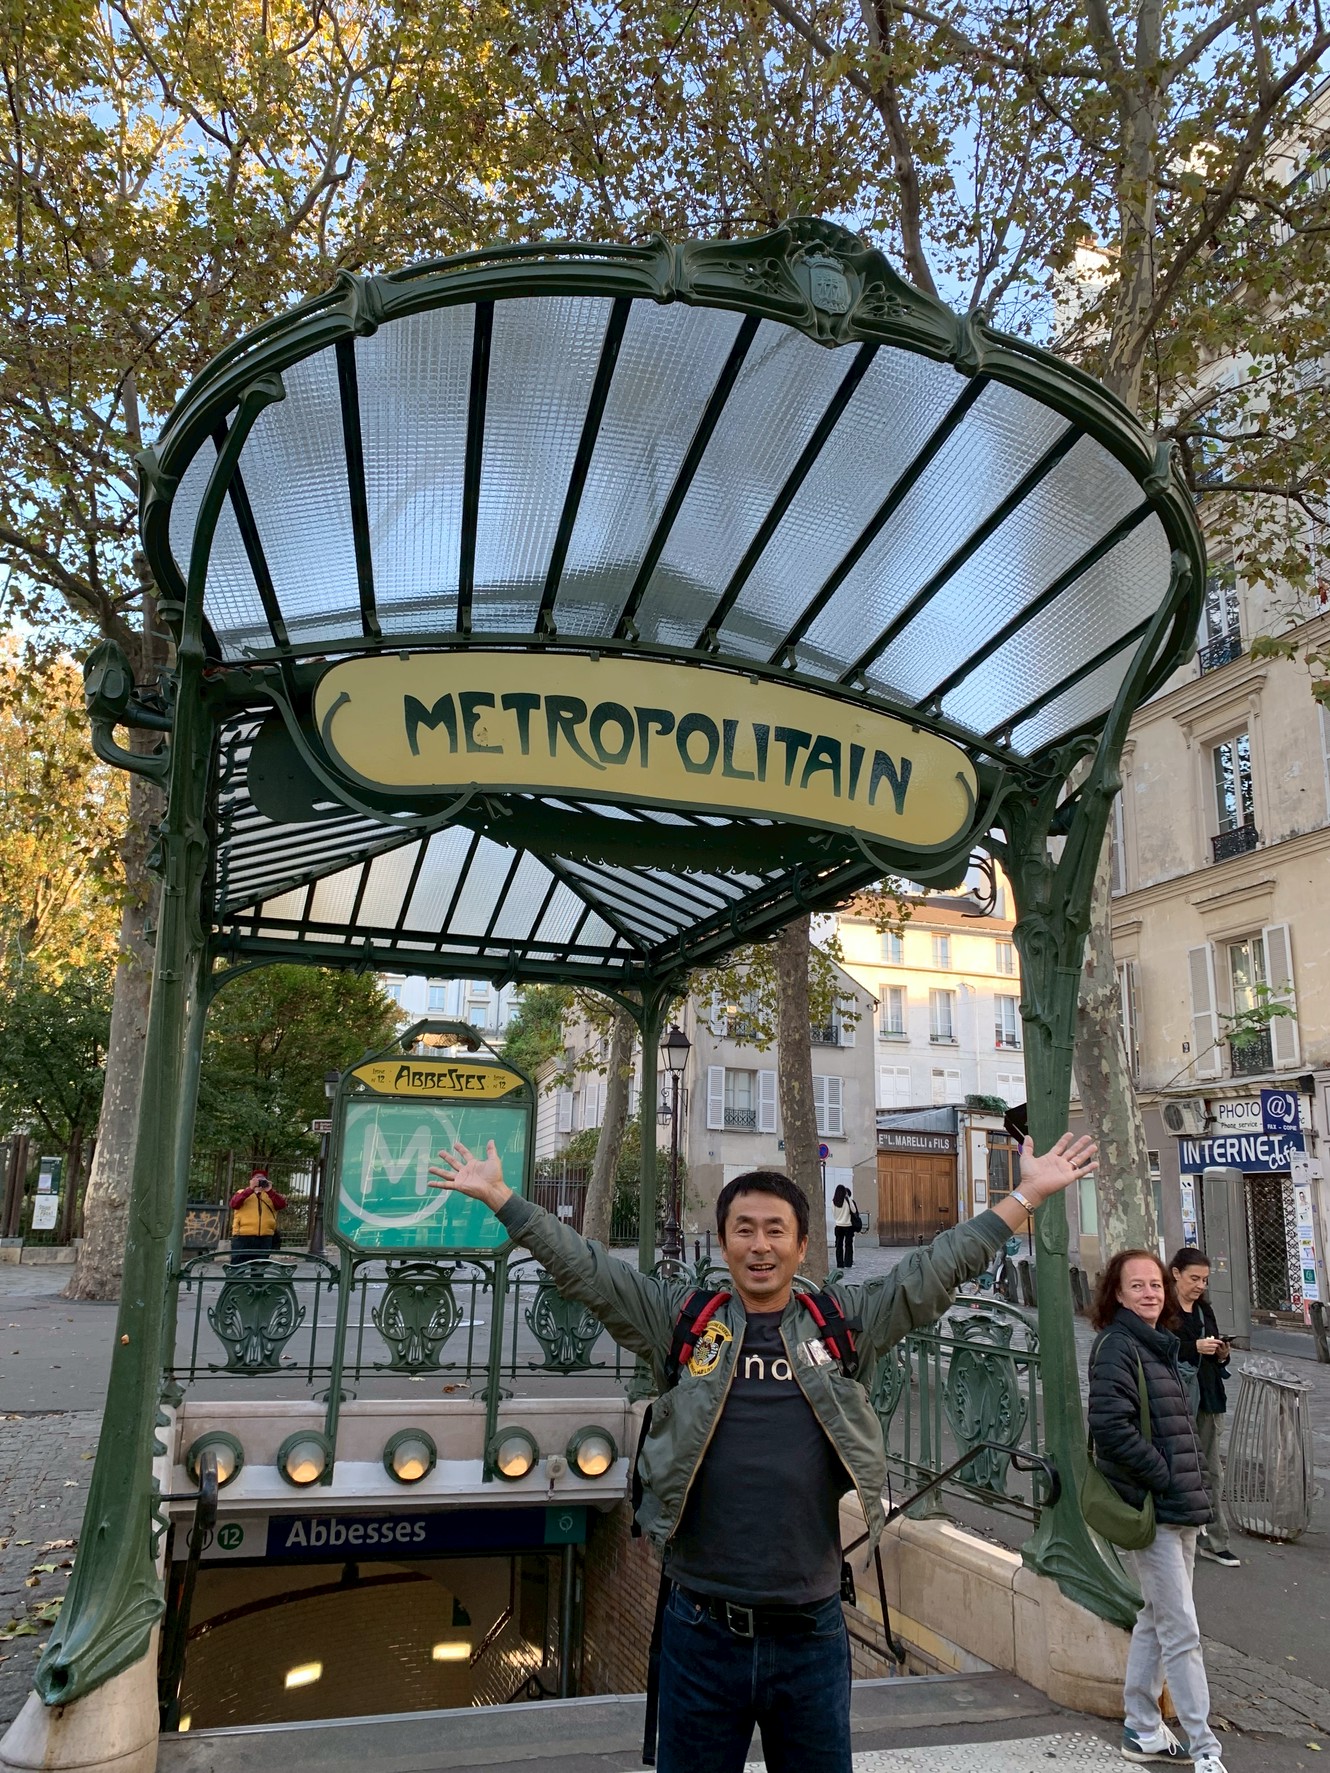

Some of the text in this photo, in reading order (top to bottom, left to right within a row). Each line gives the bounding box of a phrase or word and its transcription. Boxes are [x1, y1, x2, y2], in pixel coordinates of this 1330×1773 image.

[403, 691, 911, 816] METROPOLITAIN
[377, 1075, 385, 1083] 12
[498, 1081, 506, 1090] 12
[1219, 1101, 1261, 1119] PHOTO
[1238, 1120, 1258, 1128] service
[933, 1138, 950, 1149] FILS
[1183, 1134, 1283, 1165] INTERNET
[220, 1528, 241, 1545] 12
[285, 1518, 426, 1547] Abbesses
